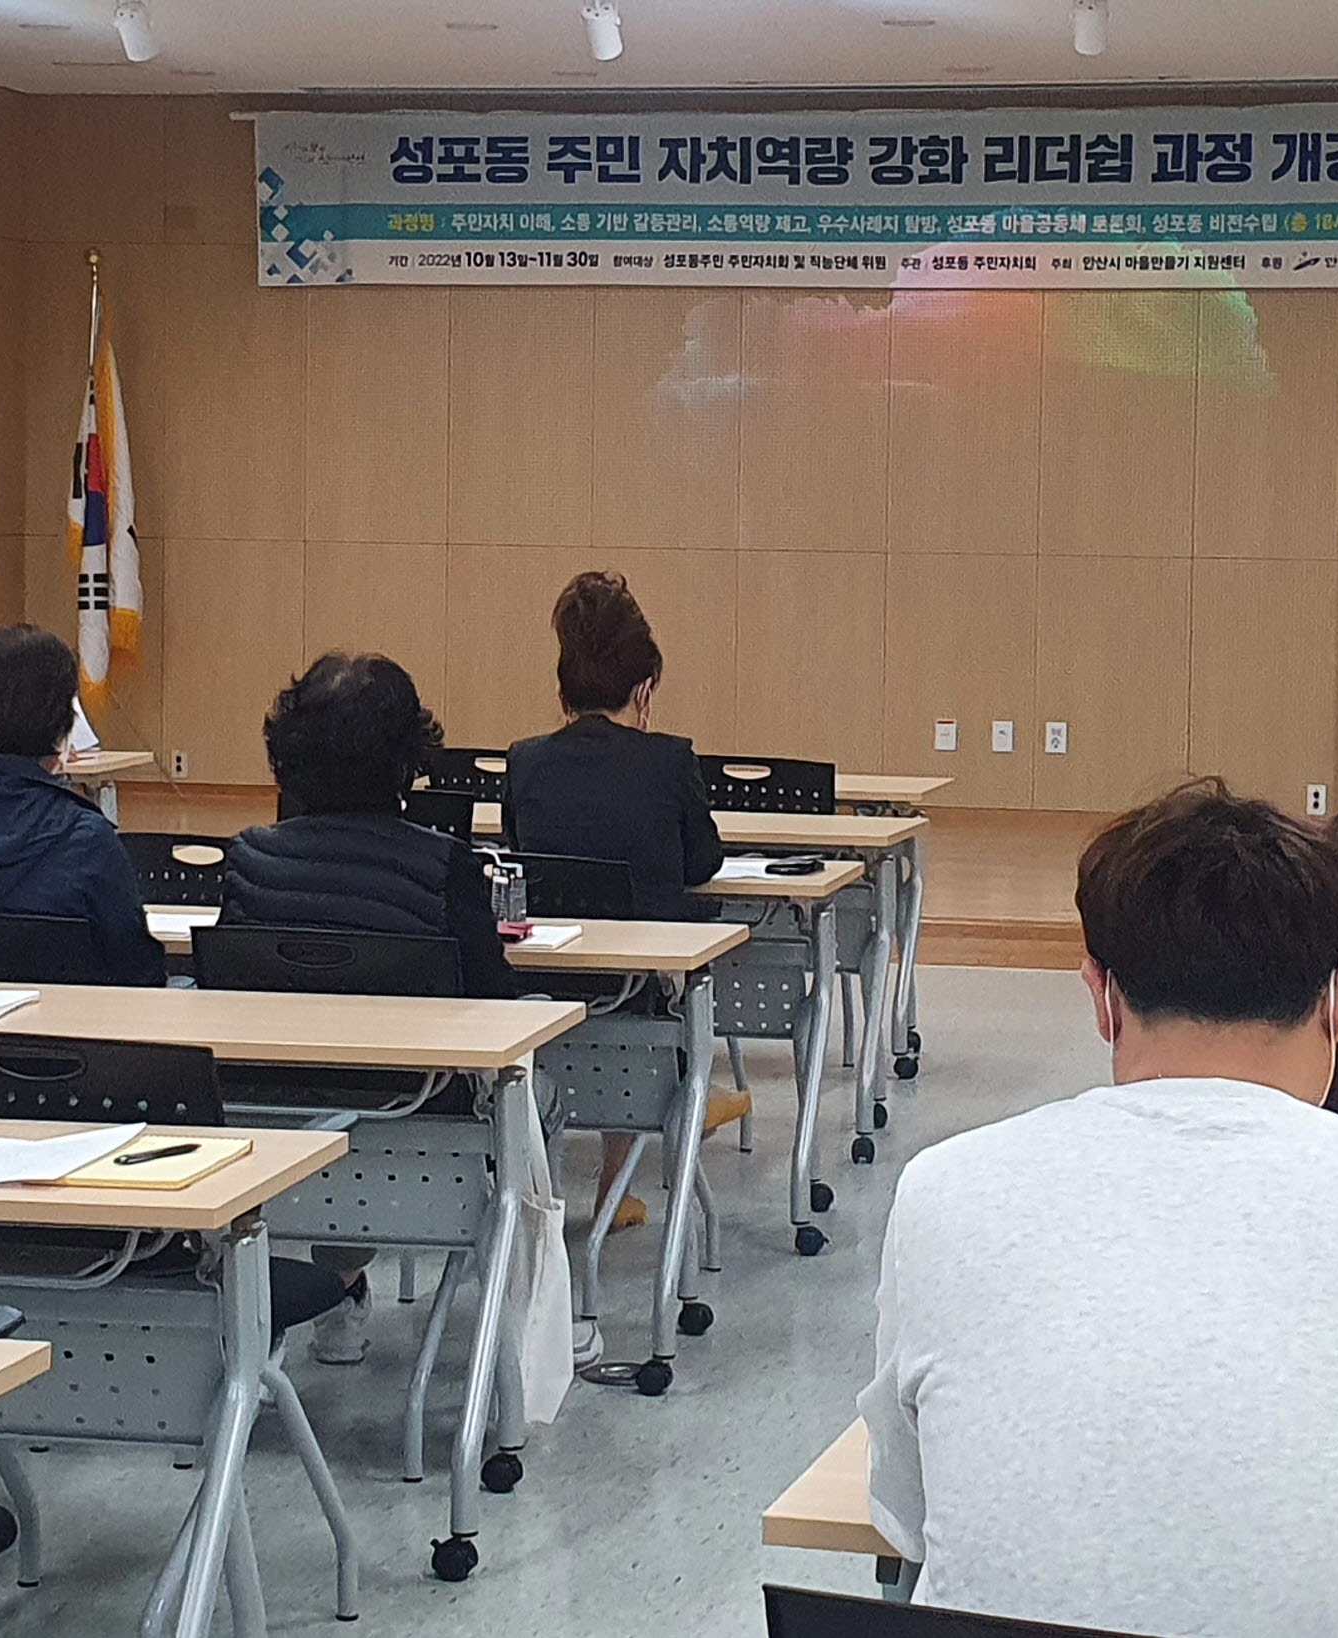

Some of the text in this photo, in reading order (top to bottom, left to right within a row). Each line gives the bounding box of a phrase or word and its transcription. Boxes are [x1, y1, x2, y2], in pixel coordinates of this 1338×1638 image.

[389, 135, 530, 185] 성포동
[546, 135, 642, 185] 주민
[657, 136, 854, 186] 자치역량
[868, 134, 969, 185] 강화
[982, 133, 1134, 184] 리더쉽
[1150, 132, 1253, 183] 과정
[387, 213, 435, 233] 과정명
[450, 213, 514, 233] 주민자치
[519, 213, 555, 233] 이해,
[561, 213, 591, 232] 소통
[596, 213, 629, 232] 기반
[632, 213, 702, 233] 갈등관리,
[707, 213, 771, 233] 소통역량
[775, 214, 811, 233] 제고,
[816, 213, 899, 234] 우수사례지
[904, 214, 942, 234] 탐방,
[947, 213, 997, 234] 성포동
[1002, 213, 1086, 234] 마을공동체
[1091, 214, 1147, 234] 토론회,
[1151, 213, 1203, 233] 성포동
[1209, 213, 1278, 233] 비전수립
[388, 254, 409, 268] 기간
[418, 254, 462, 268] 2022년
[464, 251, 495, 268] 10월
[497, 251, 564, 268] 13일~11월
[566, 251, 600, 268] 30일
[613, 255, 654, 268] 참여대상
[727, 254, 789, 269] 주민자치회
[793, 255, 805, 269] 및
[810, 255, 858, 270] 직능단체
[862, 255, 887, 270] 위원
[900, 256, 921, 270] 주관
[931, 255, 969, 270] 성포동
[973, 255, 1037, 270] 주민자치회
[1082, 255, 1121, 270] 안산시
[1125, 255, 1190, 270] 마을만들기
[1193, 254, 1246, 270] 지원센터
